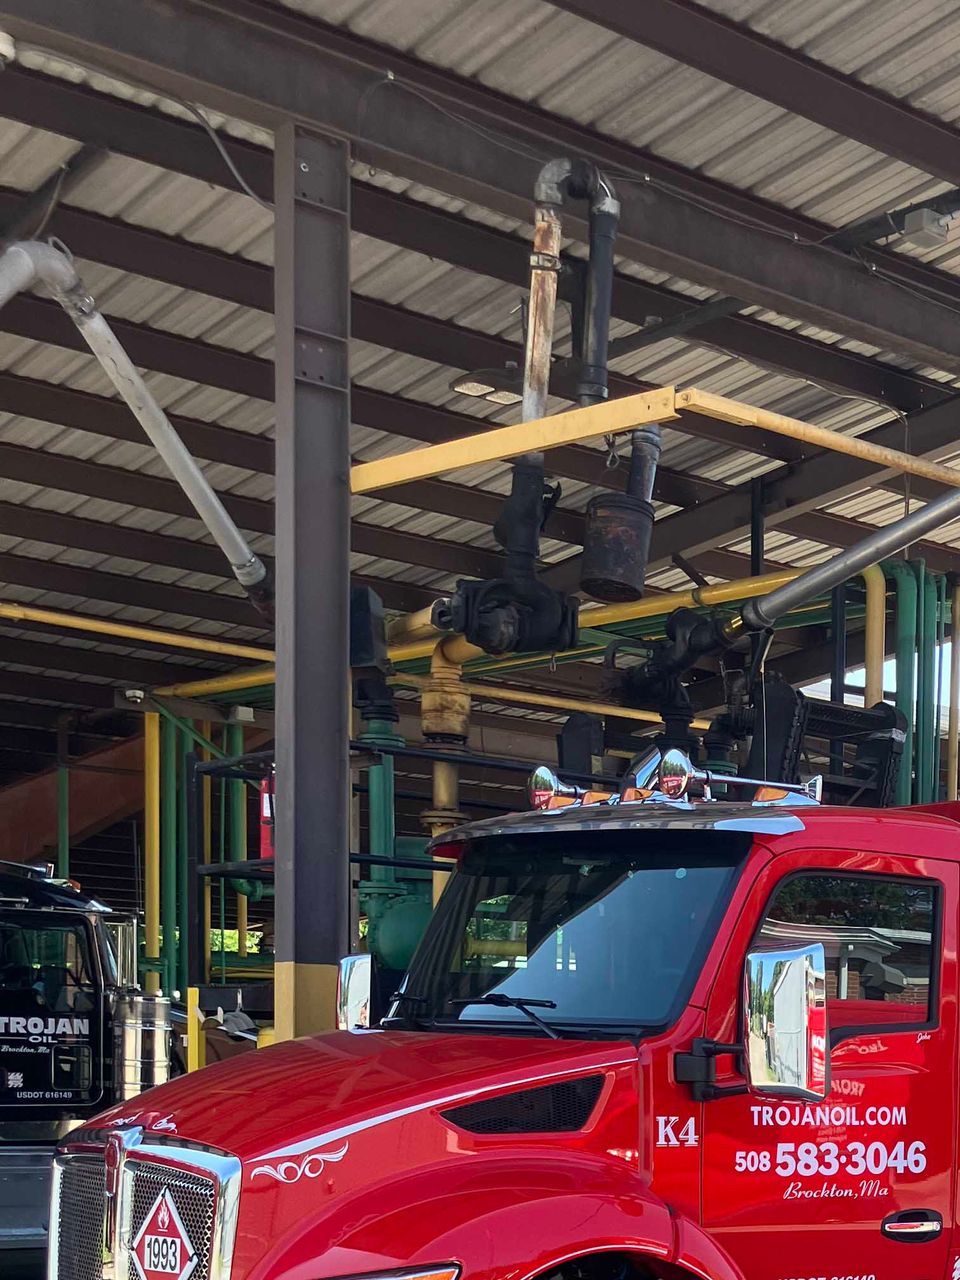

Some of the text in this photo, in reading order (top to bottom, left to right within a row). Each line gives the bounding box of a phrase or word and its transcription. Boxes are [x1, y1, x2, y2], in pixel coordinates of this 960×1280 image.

[0, 1016, 90, 1035] TROJAN
[16, 1091, 72, 1099] USDOT 616149
[750, 1106, 907, 1126] TROJANOIL.COM
[655, 1116, 699, 1147] K4
[734, 1151, 771, 1172] 508
[146, 1237, 178, 1272] 1993
